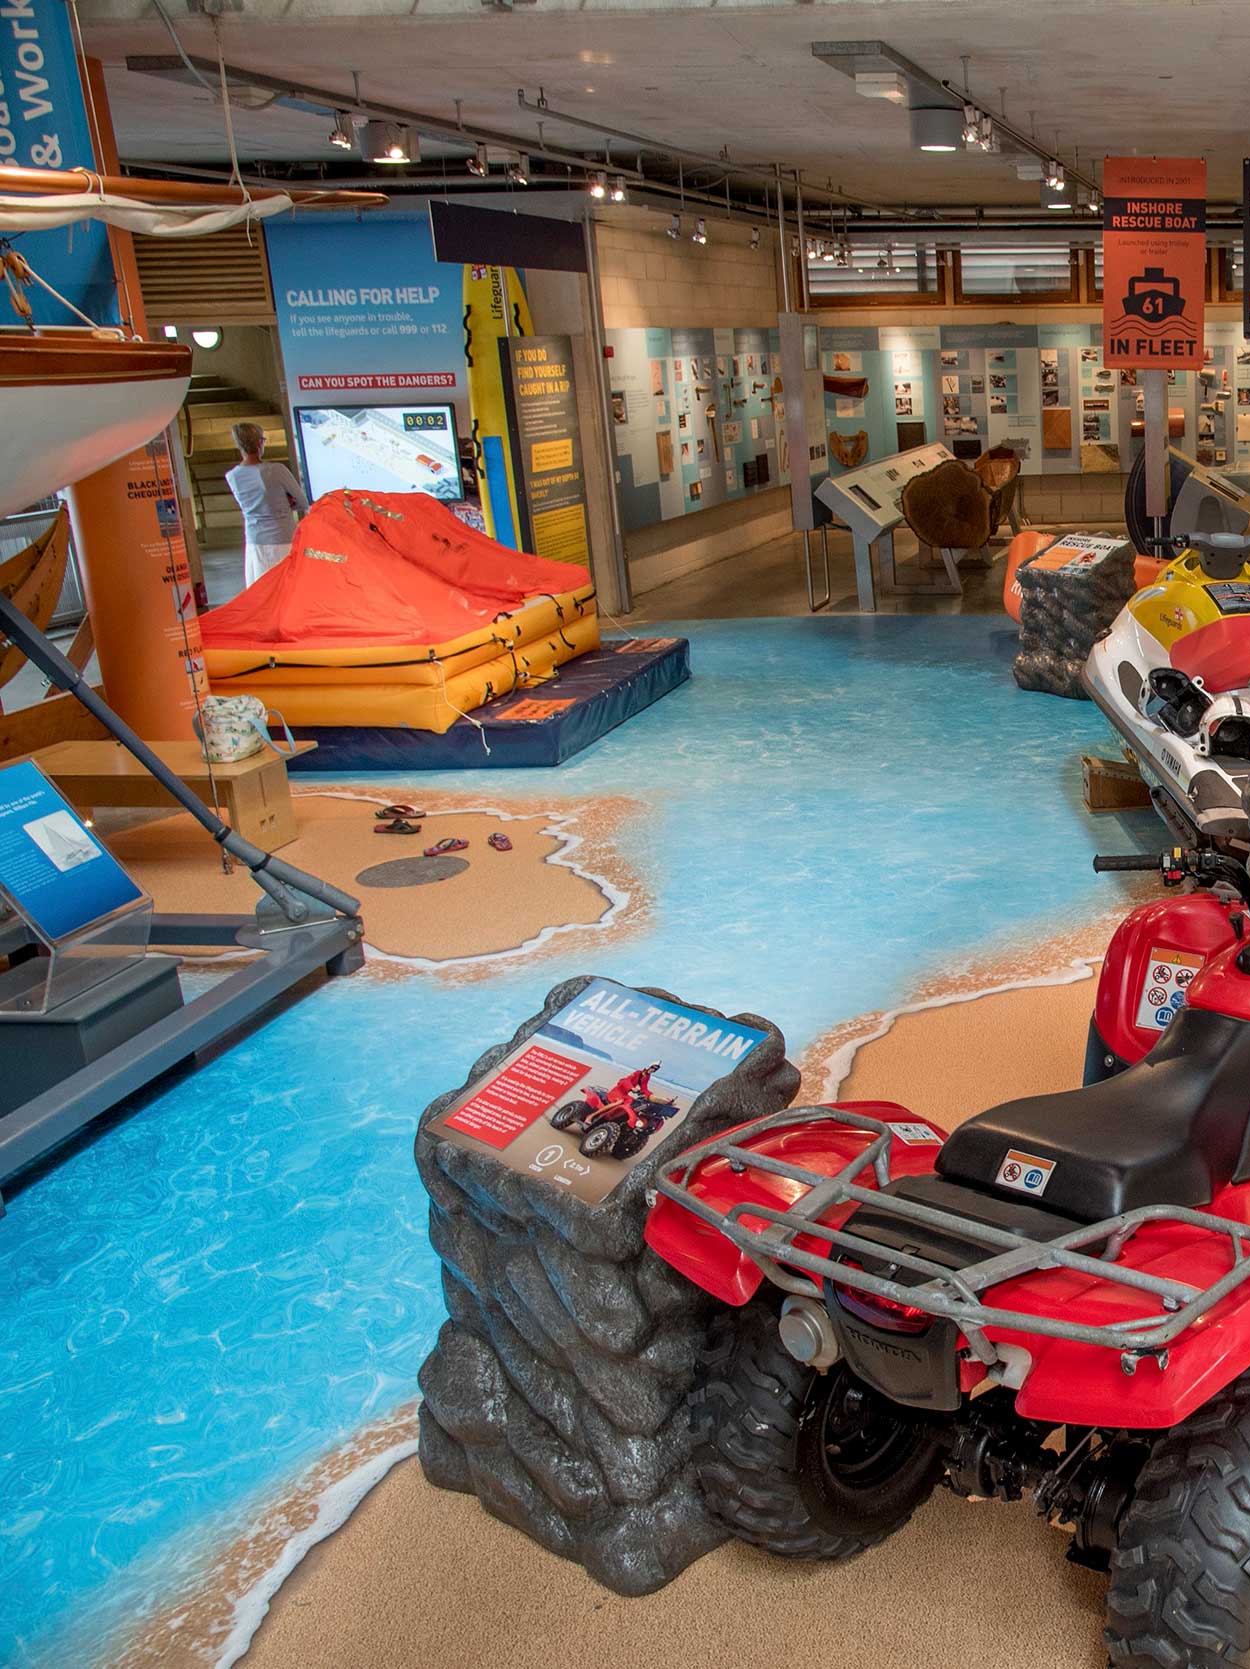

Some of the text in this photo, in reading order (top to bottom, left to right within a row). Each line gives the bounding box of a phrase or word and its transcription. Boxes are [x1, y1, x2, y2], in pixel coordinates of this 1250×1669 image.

[1127, 202, 1183, 214] INSHORE
[1112, 216, 1198, 229] RESCUE BOAT
[286, 286, 440, 307] CALLING FOR HELP
[490, 265, 504, 320] Lifeguar
[1141, 297, 1163, 315] 61
[334, 315, 366, 325] anyone
[1109, 339, 1197, 357] IN FLEET
[301, 374, 453, 389] CAN YOU SPOT THE DANGERS?
[1060, 540, 1093, 549] RESCUE
[563, 1009, 649, 1052] VEHICLE
[579, 989, 754, 1061] ALL-TERRAIN
